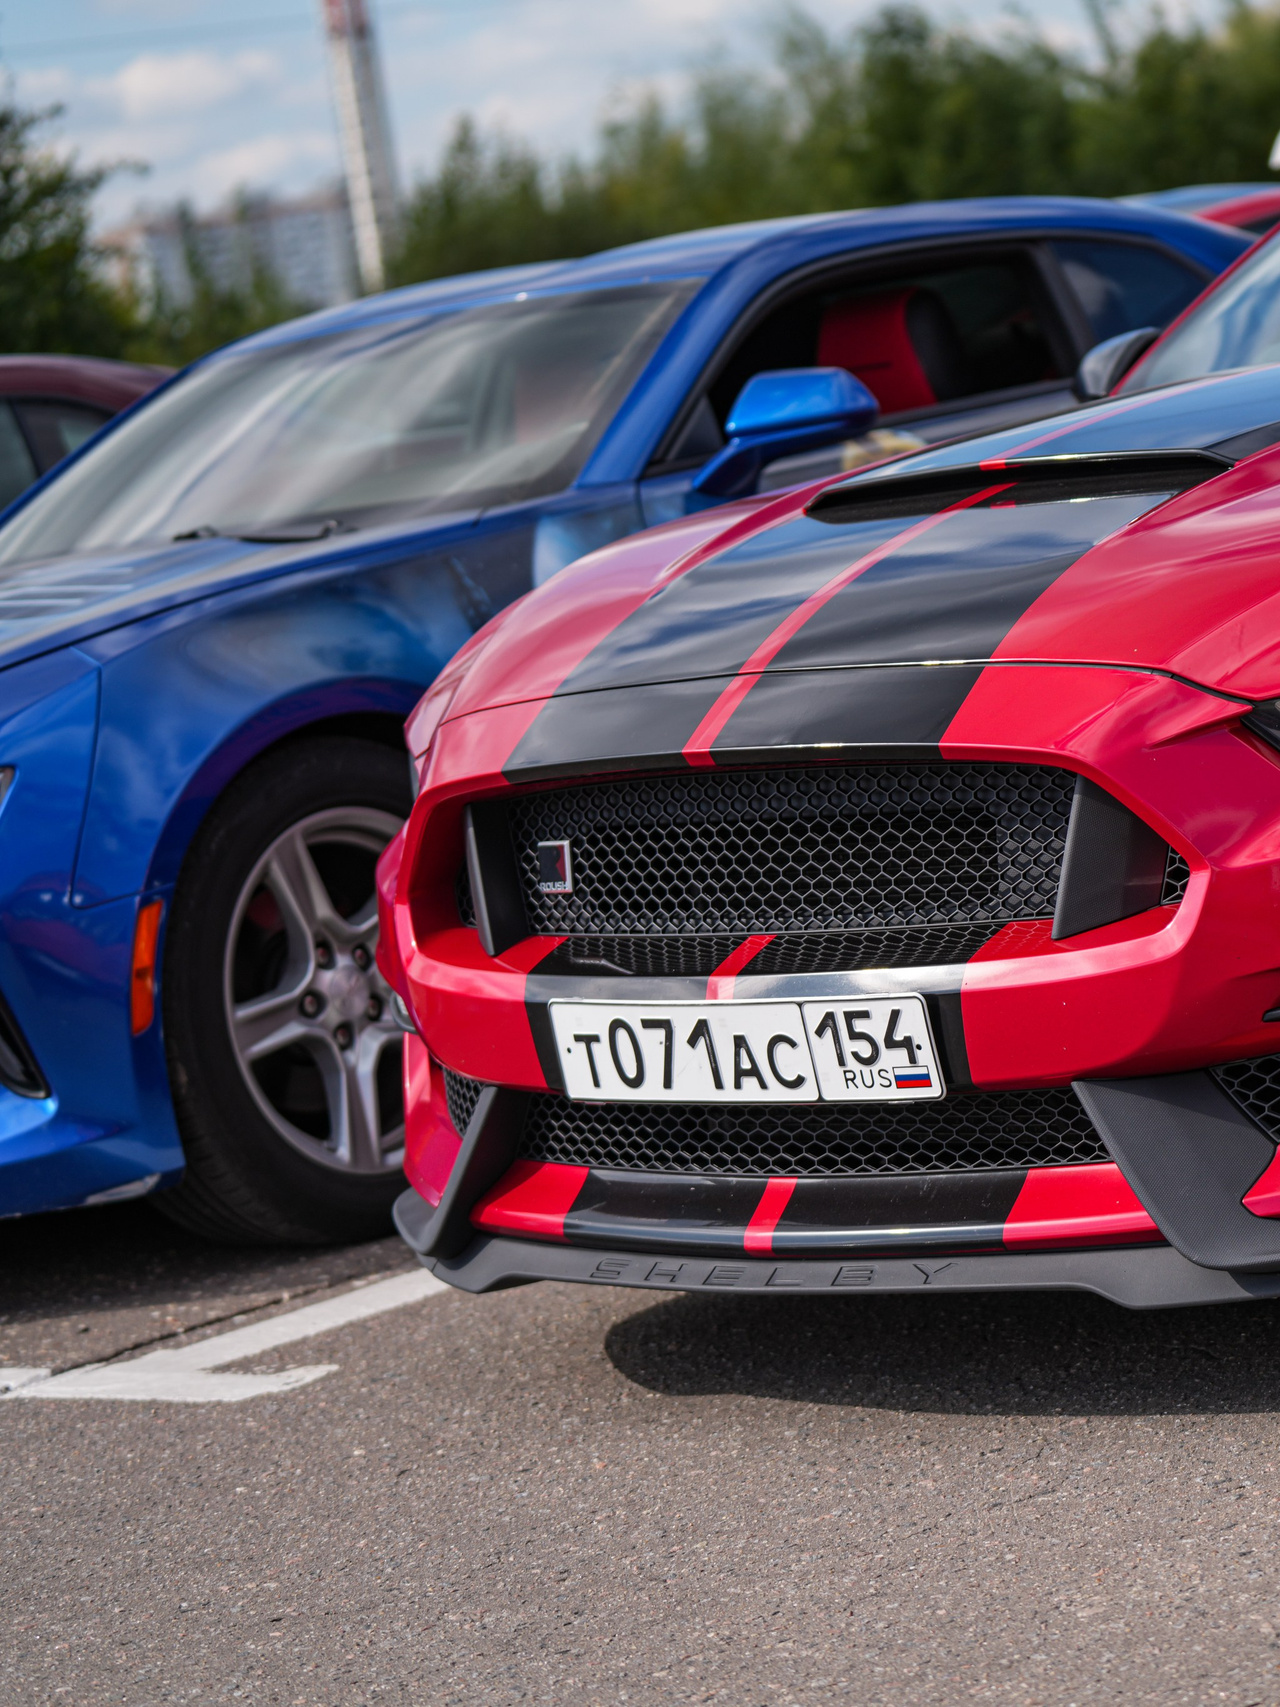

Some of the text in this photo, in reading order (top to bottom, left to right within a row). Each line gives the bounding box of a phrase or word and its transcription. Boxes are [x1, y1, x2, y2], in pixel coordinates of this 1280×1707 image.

[814, 1008, 917, 1068] 154
[843, 1067, 893, 1091] RUS
[590, 1257, 960, 1288] SHELBY
